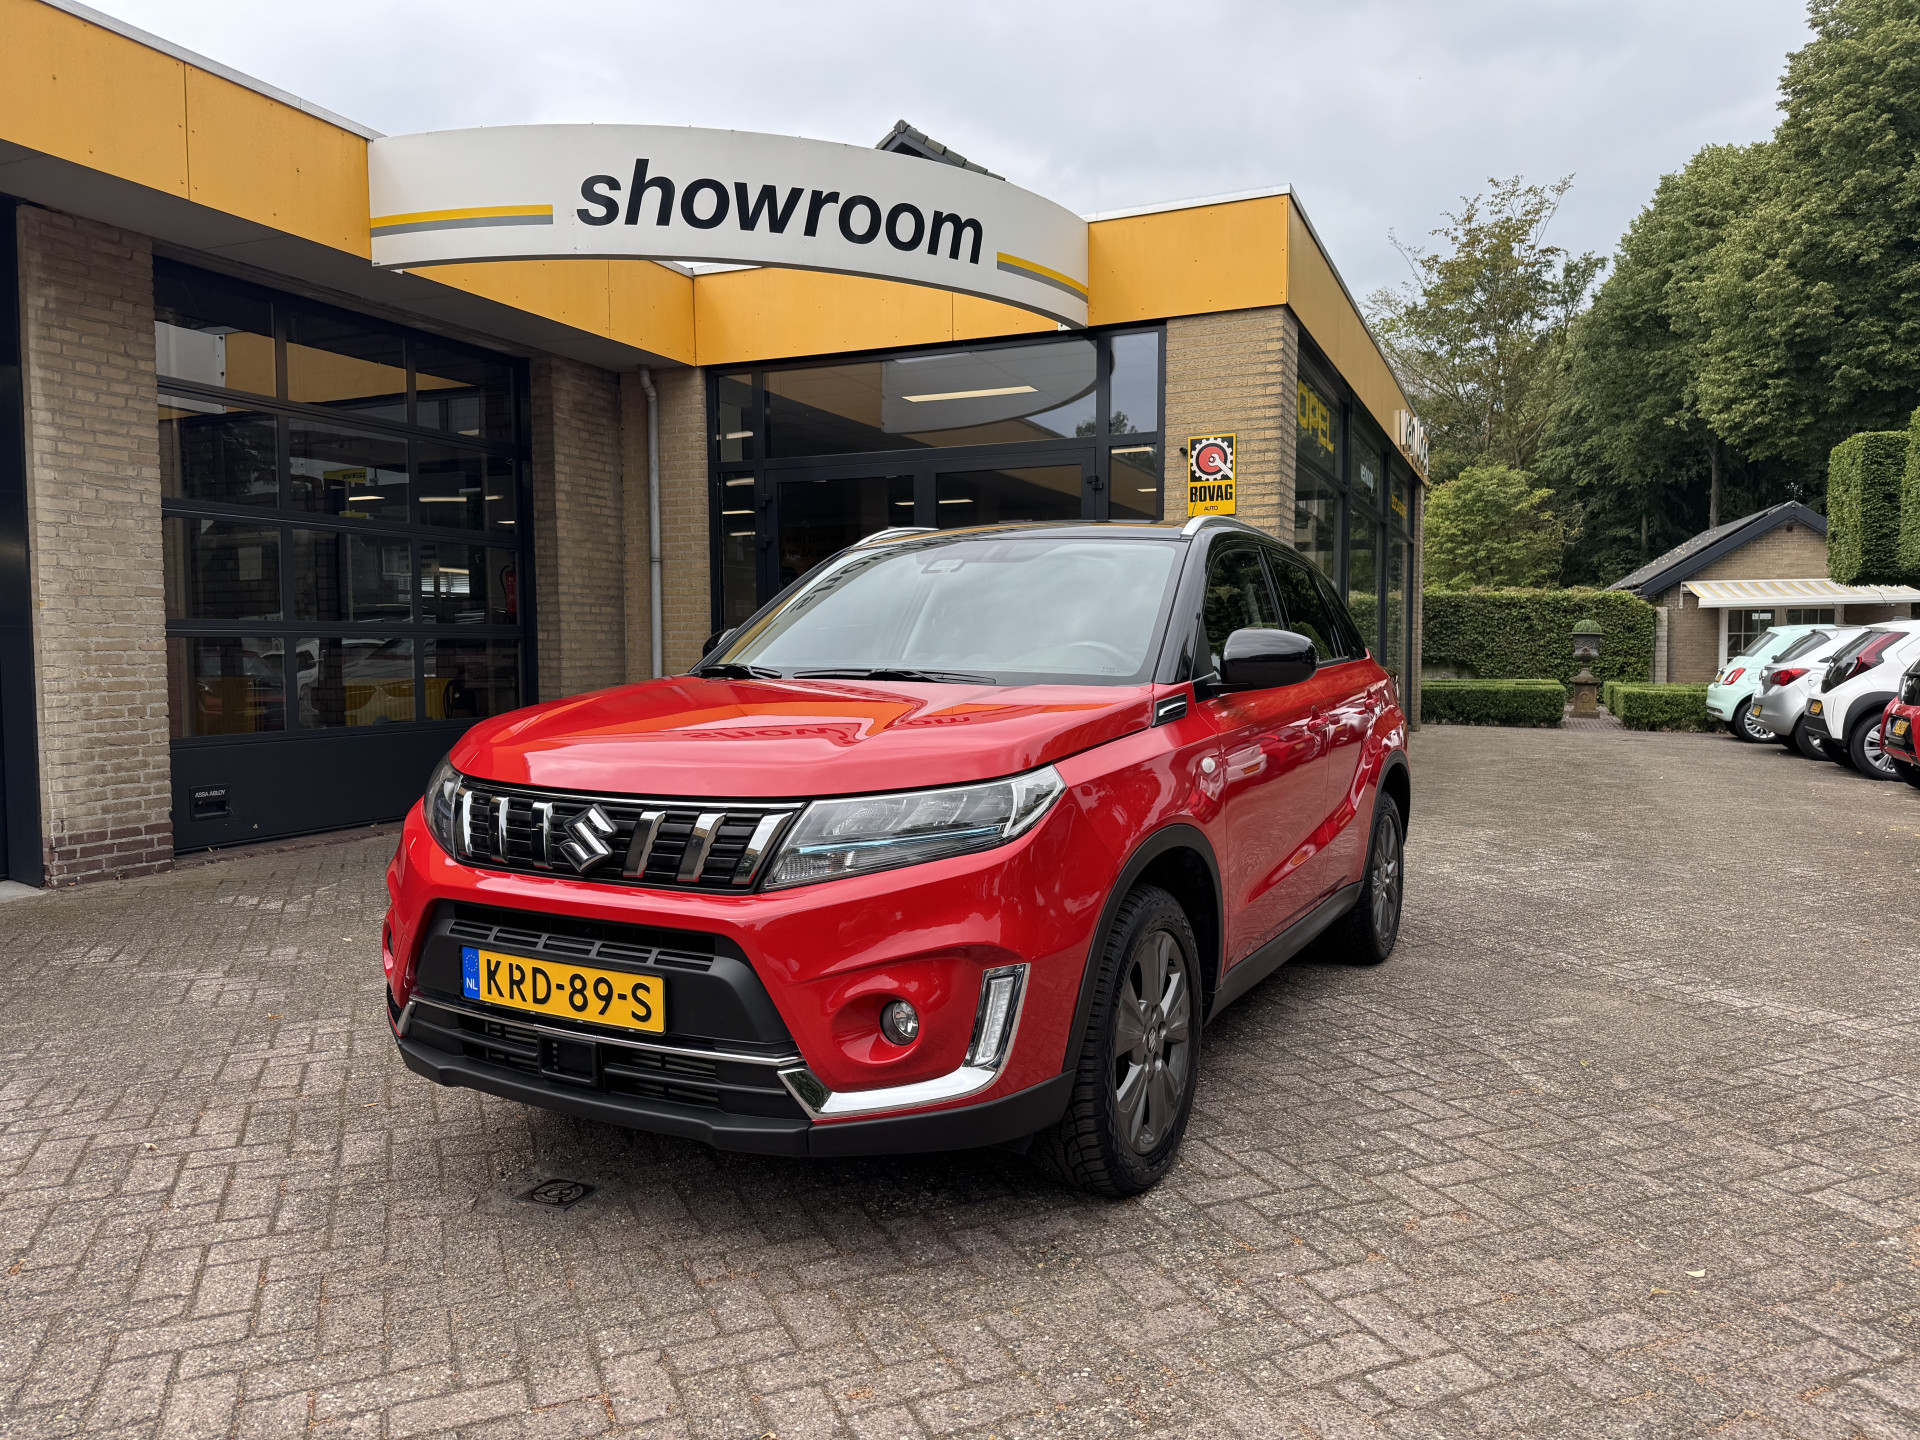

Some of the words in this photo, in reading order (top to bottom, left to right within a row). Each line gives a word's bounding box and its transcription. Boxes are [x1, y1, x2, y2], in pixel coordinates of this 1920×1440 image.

[576, 158, 984, 265] showroom
[1297, 379, 1335, 454] OPEL
[1190, 484, 1233, 503] BOVAG
[466, 977, 478, 991] NL
[486, 958, 652, 1023] KRD-89-S
